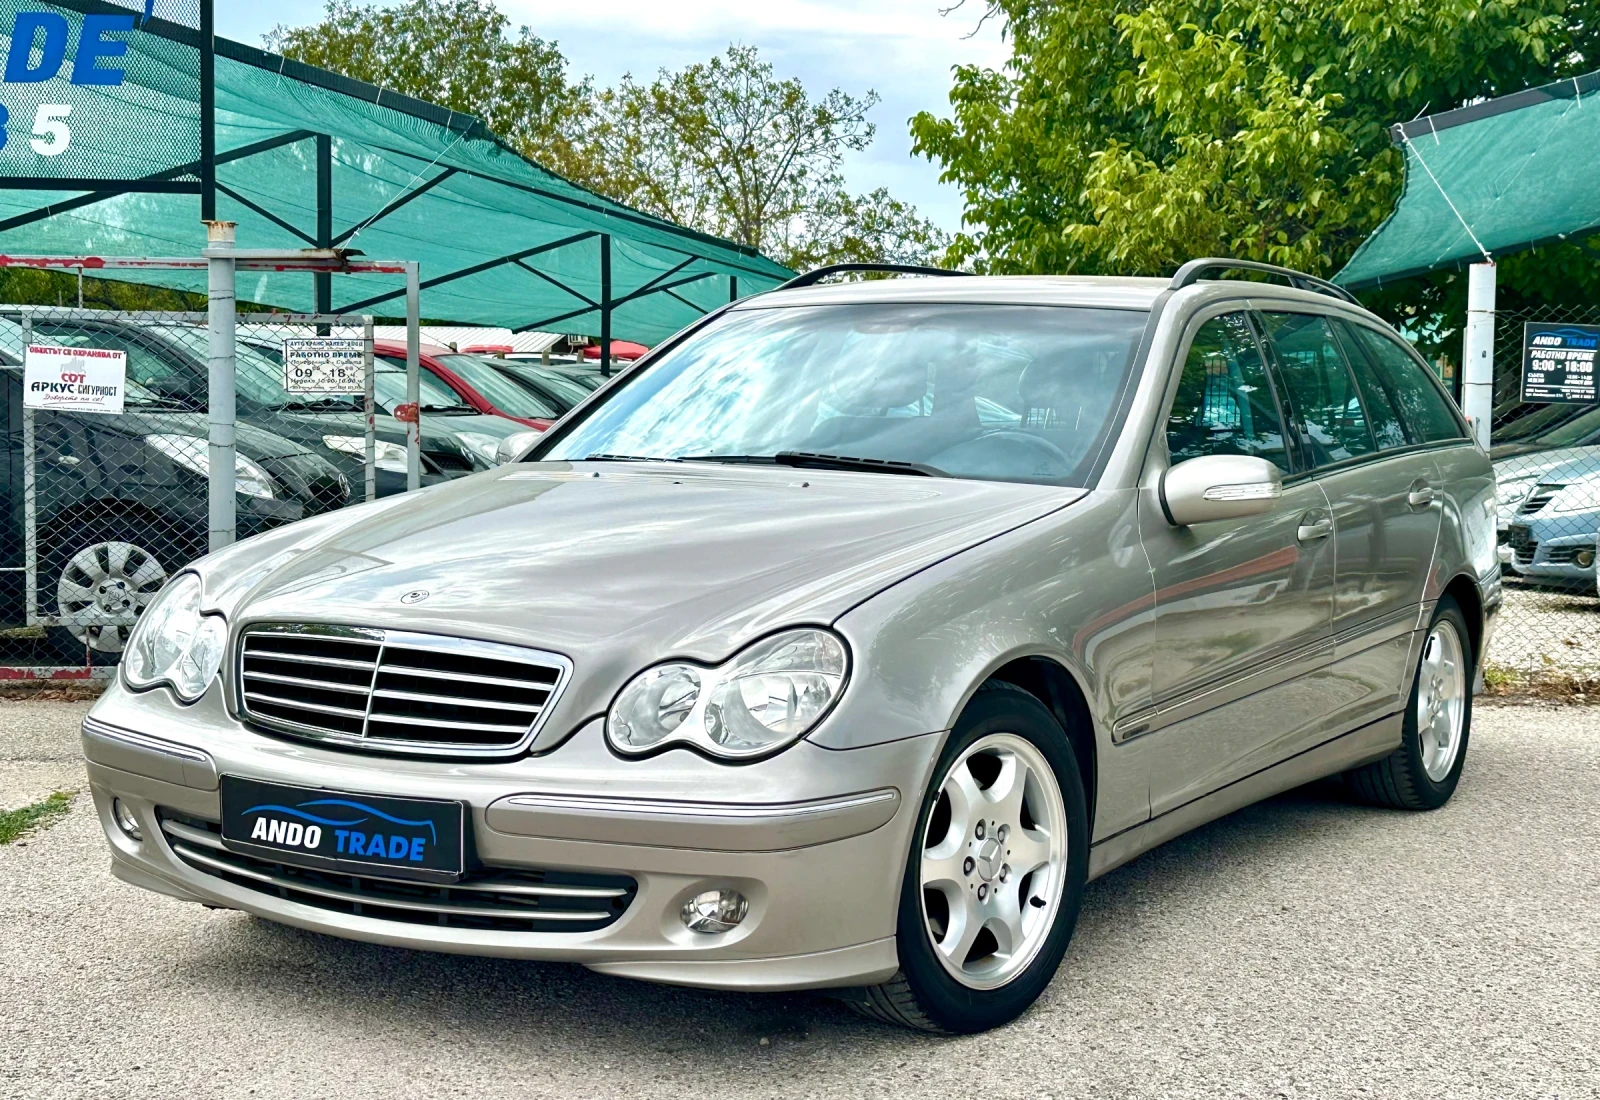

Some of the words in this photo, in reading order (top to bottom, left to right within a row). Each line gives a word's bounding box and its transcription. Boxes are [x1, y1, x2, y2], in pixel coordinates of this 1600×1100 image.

[1532, 336, 1562, 346] ANDO
[1566, 338, 1597, 347] TRADE
[63, 348, 72, 356] СЕ
[73, 349, 111, 359] ОХРАНЯВА
[1531, 350, 1566, 360] РАБОТНО
[1566, 352, 1595, 361] ВРЕМЕ
[1532, 360, 1555, 371] 9:00
[1564, 361, 1593, 372] 18:00
[61, 373, 86, 383] СОТ
[251, 817, 322, 849] ANDO
[334, 829, 426, 862] TRADE
